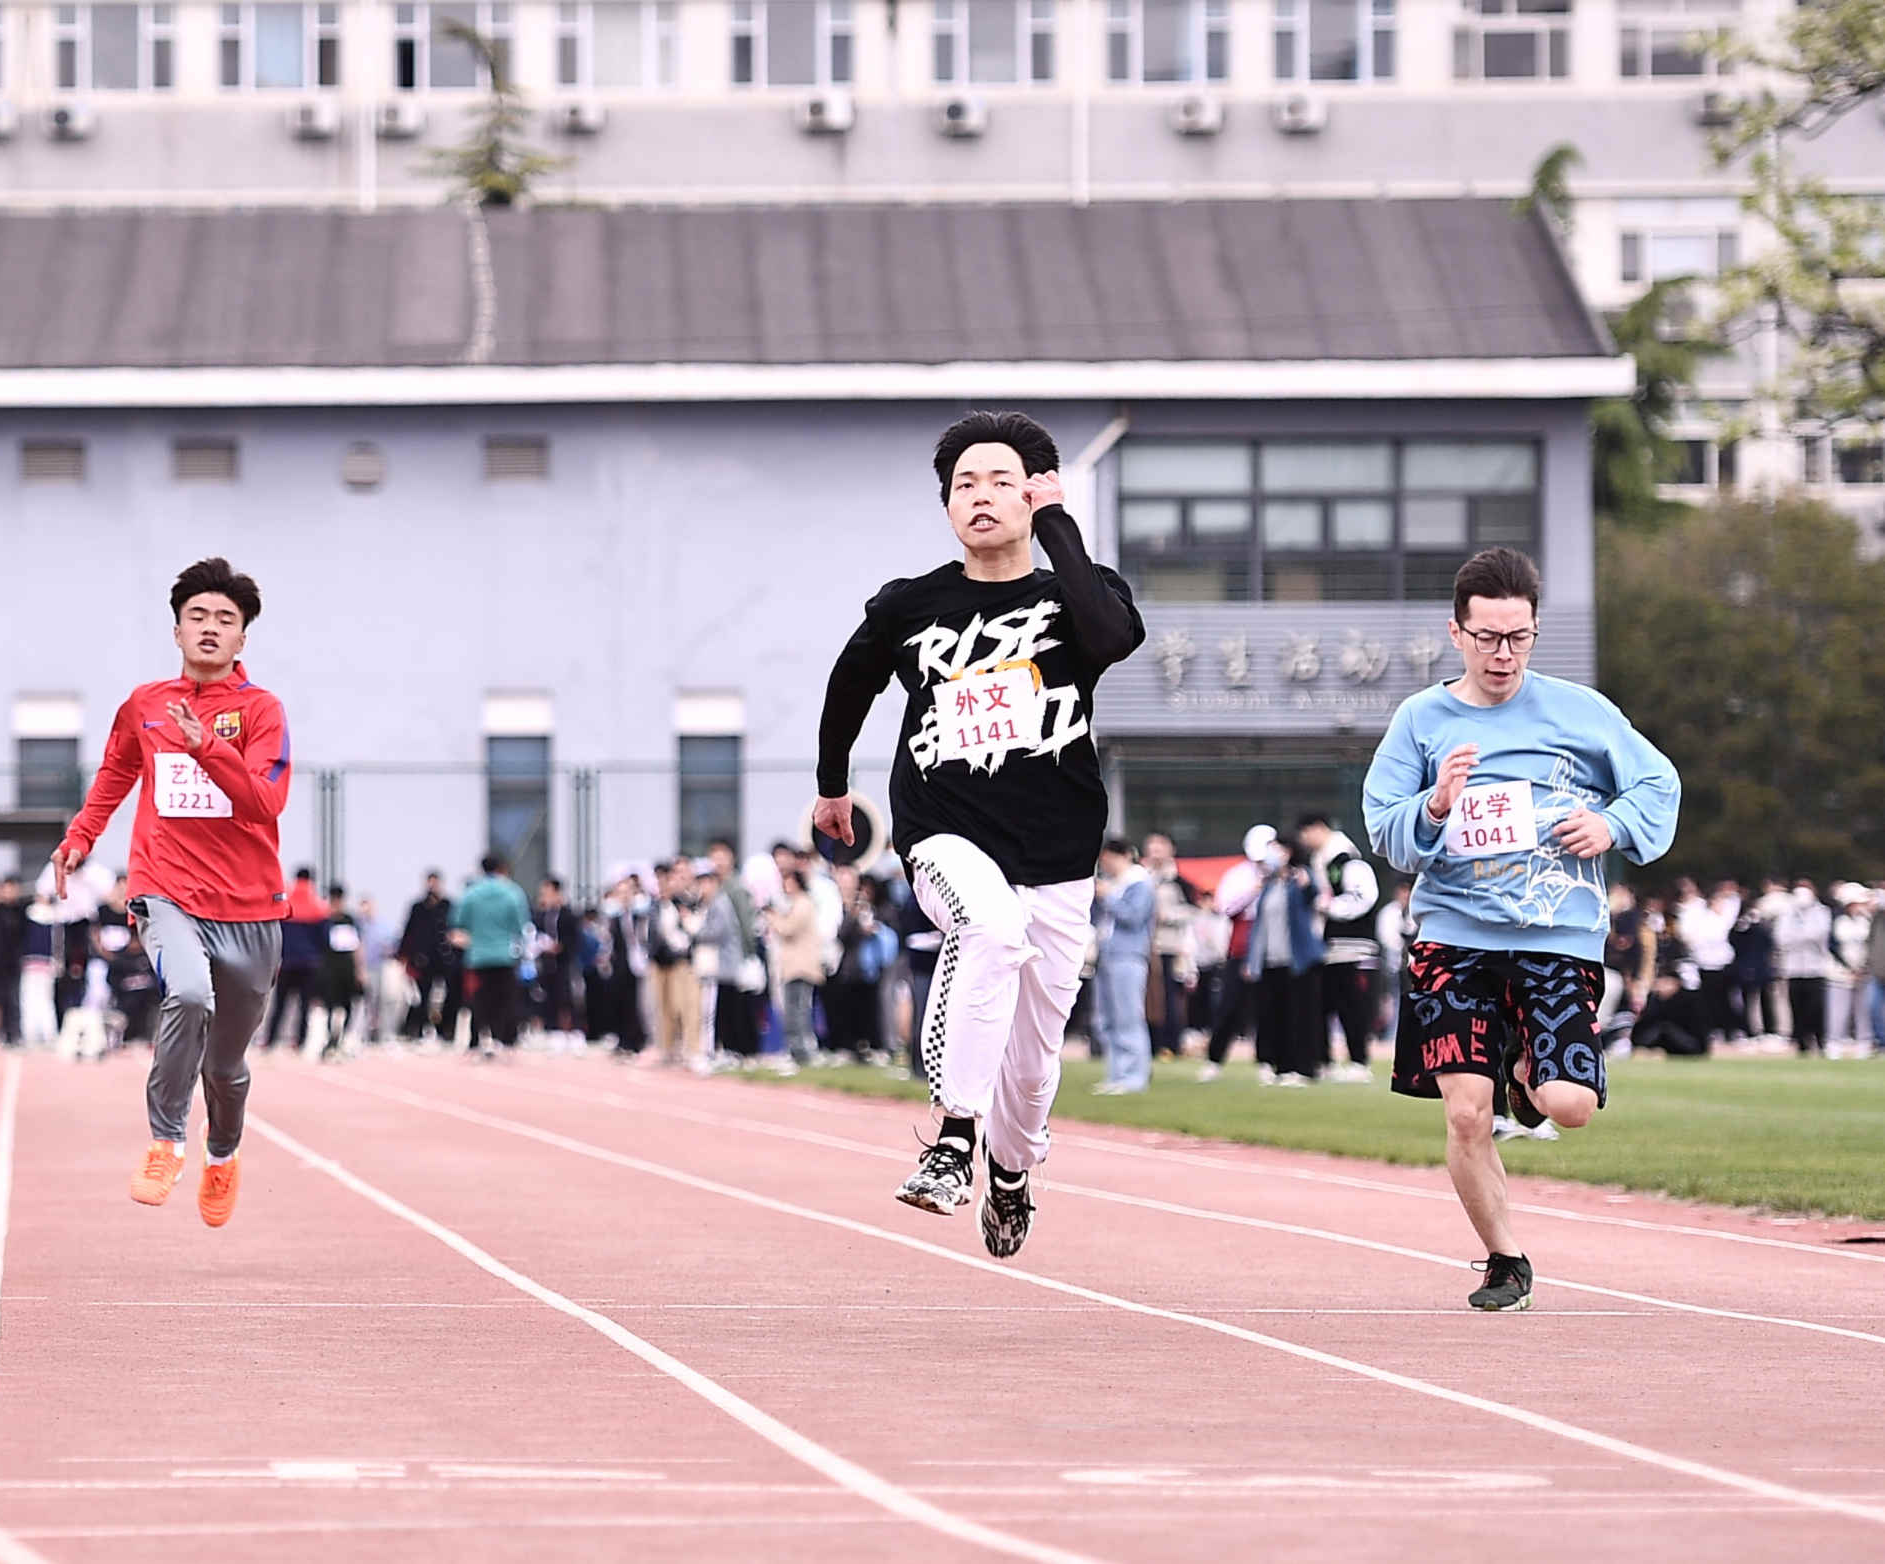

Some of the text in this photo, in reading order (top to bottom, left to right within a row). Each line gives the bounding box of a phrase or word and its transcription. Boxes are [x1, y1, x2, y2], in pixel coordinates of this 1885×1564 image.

[902, 599, 1064, 690] RISE
[955, 683, 1011, 716] 外文
[956, 719, 1019, 748] 1141
[168, 793, 215, 810] 1221
[1460, 792, 1512, 822] 化学
[1460, 825, 1518, 848] 1041
